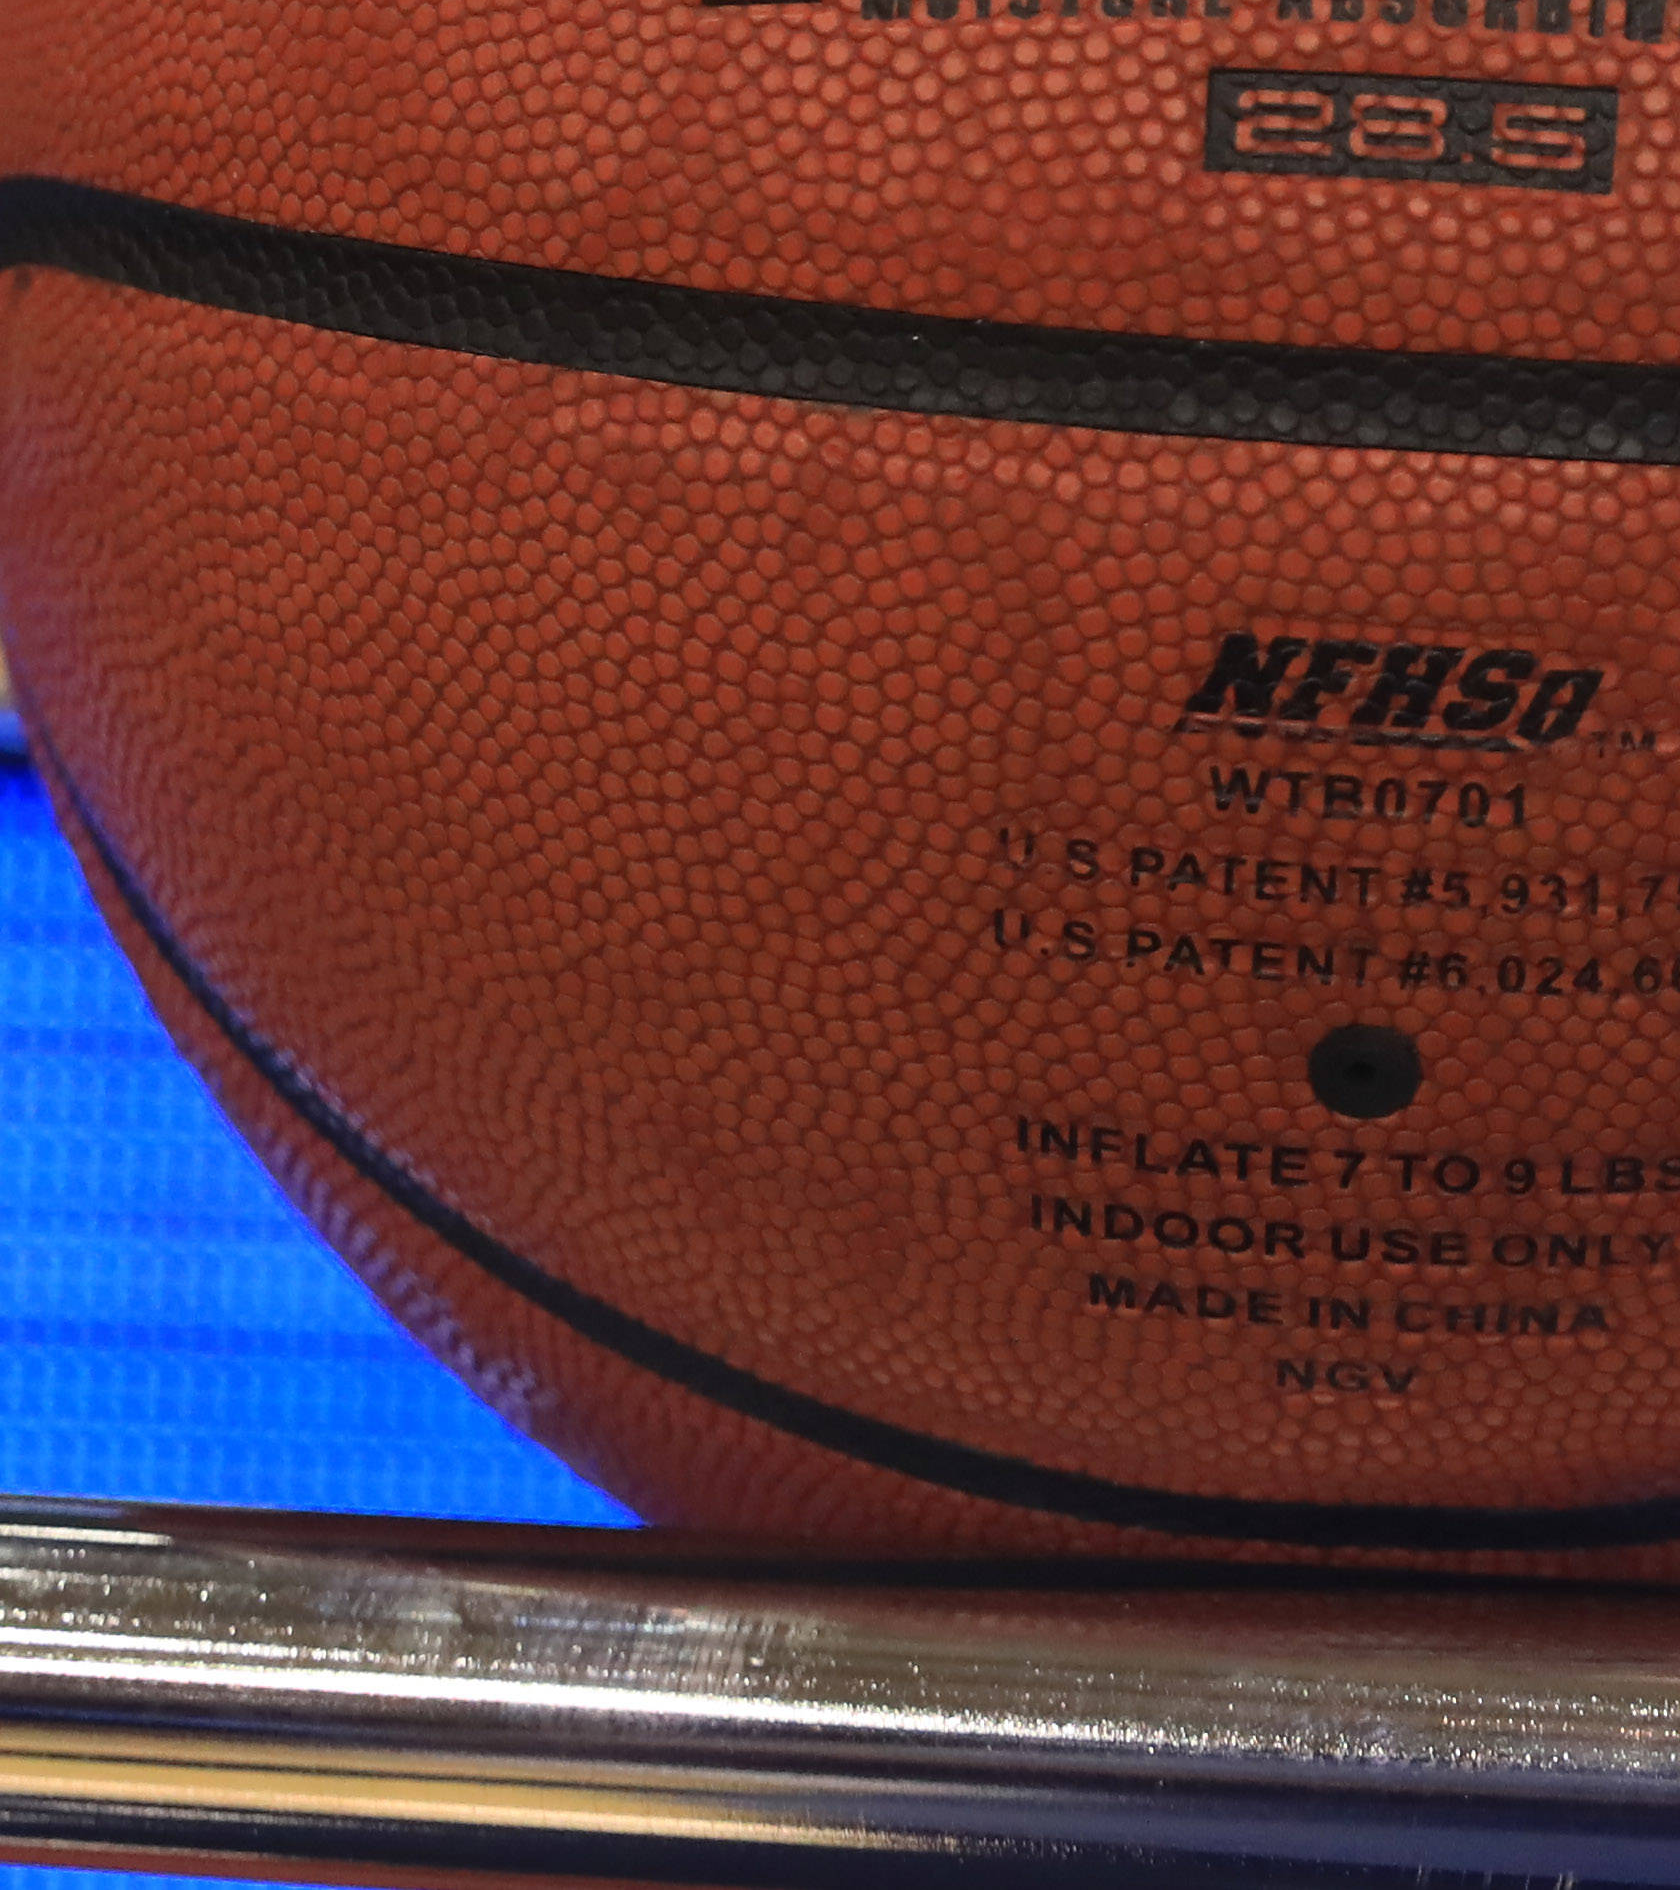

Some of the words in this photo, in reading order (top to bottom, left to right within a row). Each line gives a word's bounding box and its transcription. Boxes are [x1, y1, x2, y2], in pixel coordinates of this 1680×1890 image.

[1234, 88, 1588, 172] 28.5
[1209, 764, 1526, 828] WTB0701
[1130, 846, 1381, 907] PATENT
[1127, 930, 1376, 988] PATENT
[1016, 1116, 1310, 1187] INFLATE
[1333, 1148, 1366, 1189] 7
[1388, 1154, 1480, 1195] TO
[1504, 1156, 1536, 1195] 9
[1031, 1195, 1304, 1259] INDOOR
[1330, 1227, 1469, 1267] USE
[1492, 1232, 1672, 1269] ONLY
[1088, 1272, 1283, 1325] MADE
[1308, 1297, 1370, 1330] IN
[1395, 1302, 1609, 1336] CHINA
[1276, 1359, 1416, 1393] NGV
